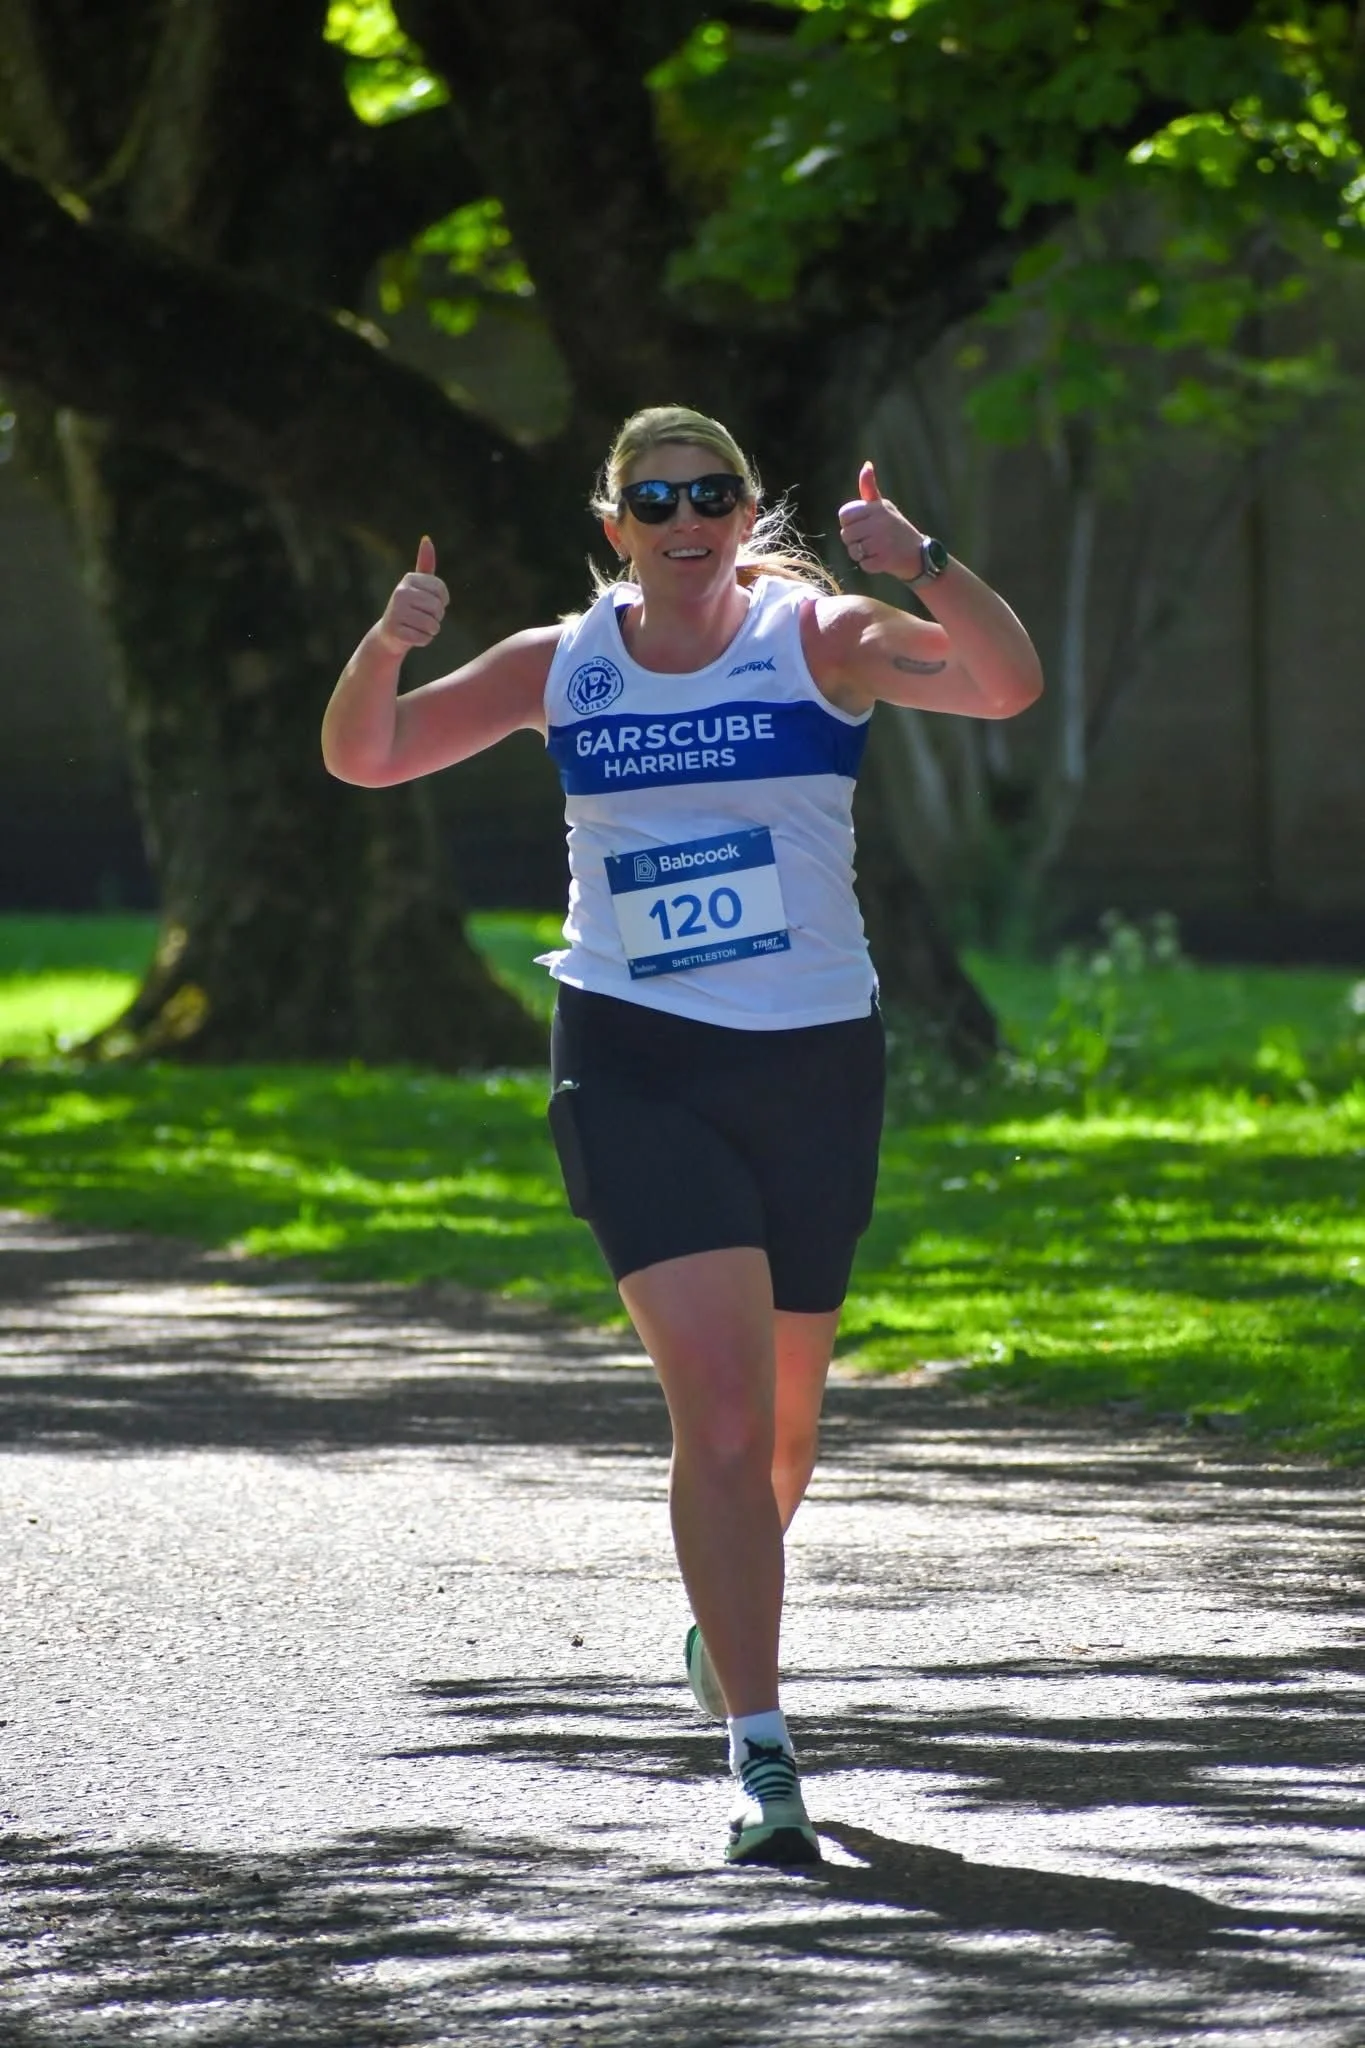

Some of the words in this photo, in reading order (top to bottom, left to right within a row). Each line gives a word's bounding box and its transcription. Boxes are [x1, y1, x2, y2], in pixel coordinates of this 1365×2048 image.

[576, 714, 775, 756] GARSCUBE
[604, 748, 736, 777] HARRIERS
[659, 843, 740, 871] Babcock
[649, 887, 742, 940] 120
[671, 948, 737, 968] SHETTLESTON
[752, 937, 779, 951] START
